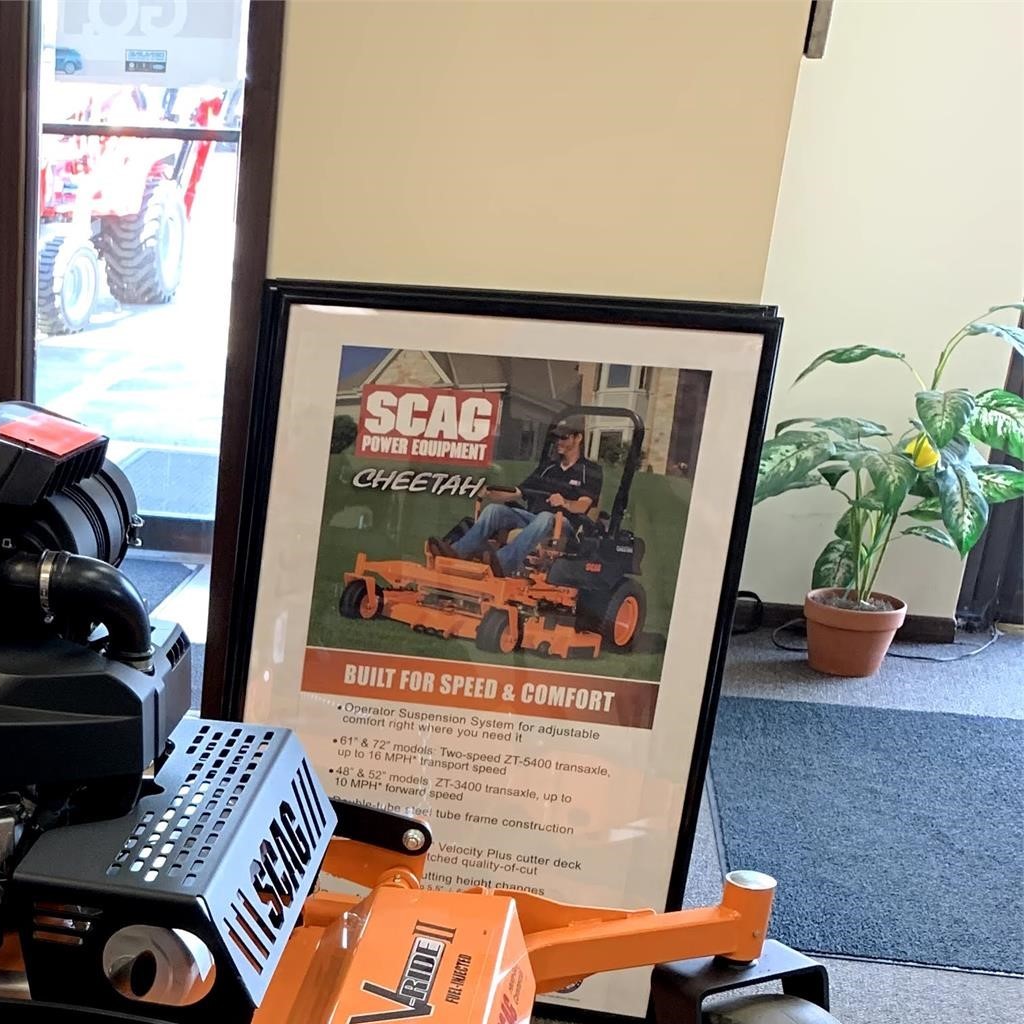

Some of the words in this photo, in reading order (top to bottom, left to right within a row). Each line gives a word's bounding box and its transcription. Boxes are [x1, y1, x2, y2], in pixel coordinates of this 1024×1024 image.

[364, 390, 493, 442] SCAG
[361, 435, 409, 455] POWER
[411, 439, 487, 461] EQUIPMENT
[352, 468, 486, 498] CHEETAH
[344, 664, 396, 689] BUILT
[399, 670, 435, 692] FOR
[439, 675, 498, 699] SPEED
[501, 684, 515, 701] &
[520, 684, 616, 712] COMFORT
[342, 715, 385, 727] comfort
[388, 719, 414, 731] right
[418, 723, 454, 735] where
[457, 727, 478, 738] you
[482, 729, 511, 742] need
[515, 732, 522, 743] it
[344, 702, 395, 717] Operator
[398, 708, 466, 725] Suspension
[470, 716, 514, 731] System
[518, 721, 534, 732] for
[538, 725, 600, 740] adjustable
[337, 749, 351, 758] up
[354, 749, 365, 759] to
[369, 751, 381, 761] 16
[420, 756, 469, 771] transport
[472, 763, 507, 776] speed
[361, 738, 369, 748] &
[372, 739, 391, 750] 72"
[440, 746, 501, 763] Two-speed
[504, 754, 552, 769] ZT-5400
[555, 761, 611, 778] transaxle,
[335, 766, 354, 776] 48"
[357, 768, 365, 778] &
[368, 769, 387, 780] 52"
[436, 777, 482, 792] ZT-3400
[485, 784, 539, 800] transaxle,
[543, 792, 558, 804] up
[561, 793, 572, 804] to
[335, 777, 348, 788] 10
[385, 783, 427, 797] forward
[429, 789, 464, 801] speed
[436, 808, 461, 821] tube
[465, 812, 498, 825] frame
[502, 817, 574, 835] construction
[250, 799, 316, 930] SCAG
[426, 852, 458, 865] tched
[461, 858, 538, 876] quality-of-cut
[438, 841, 483, 858] Velocity
[487, 848, 512, 861] Plus
[516, 852, 550, 866] cutter
[553, 858, 582, 870] deck
[422, 872, 453, 885] utting
[456, 875, 492, 888] height
[495, 881, 545, 896] changes
[445, 953, 472, 1005] FUEL-INJECTED
